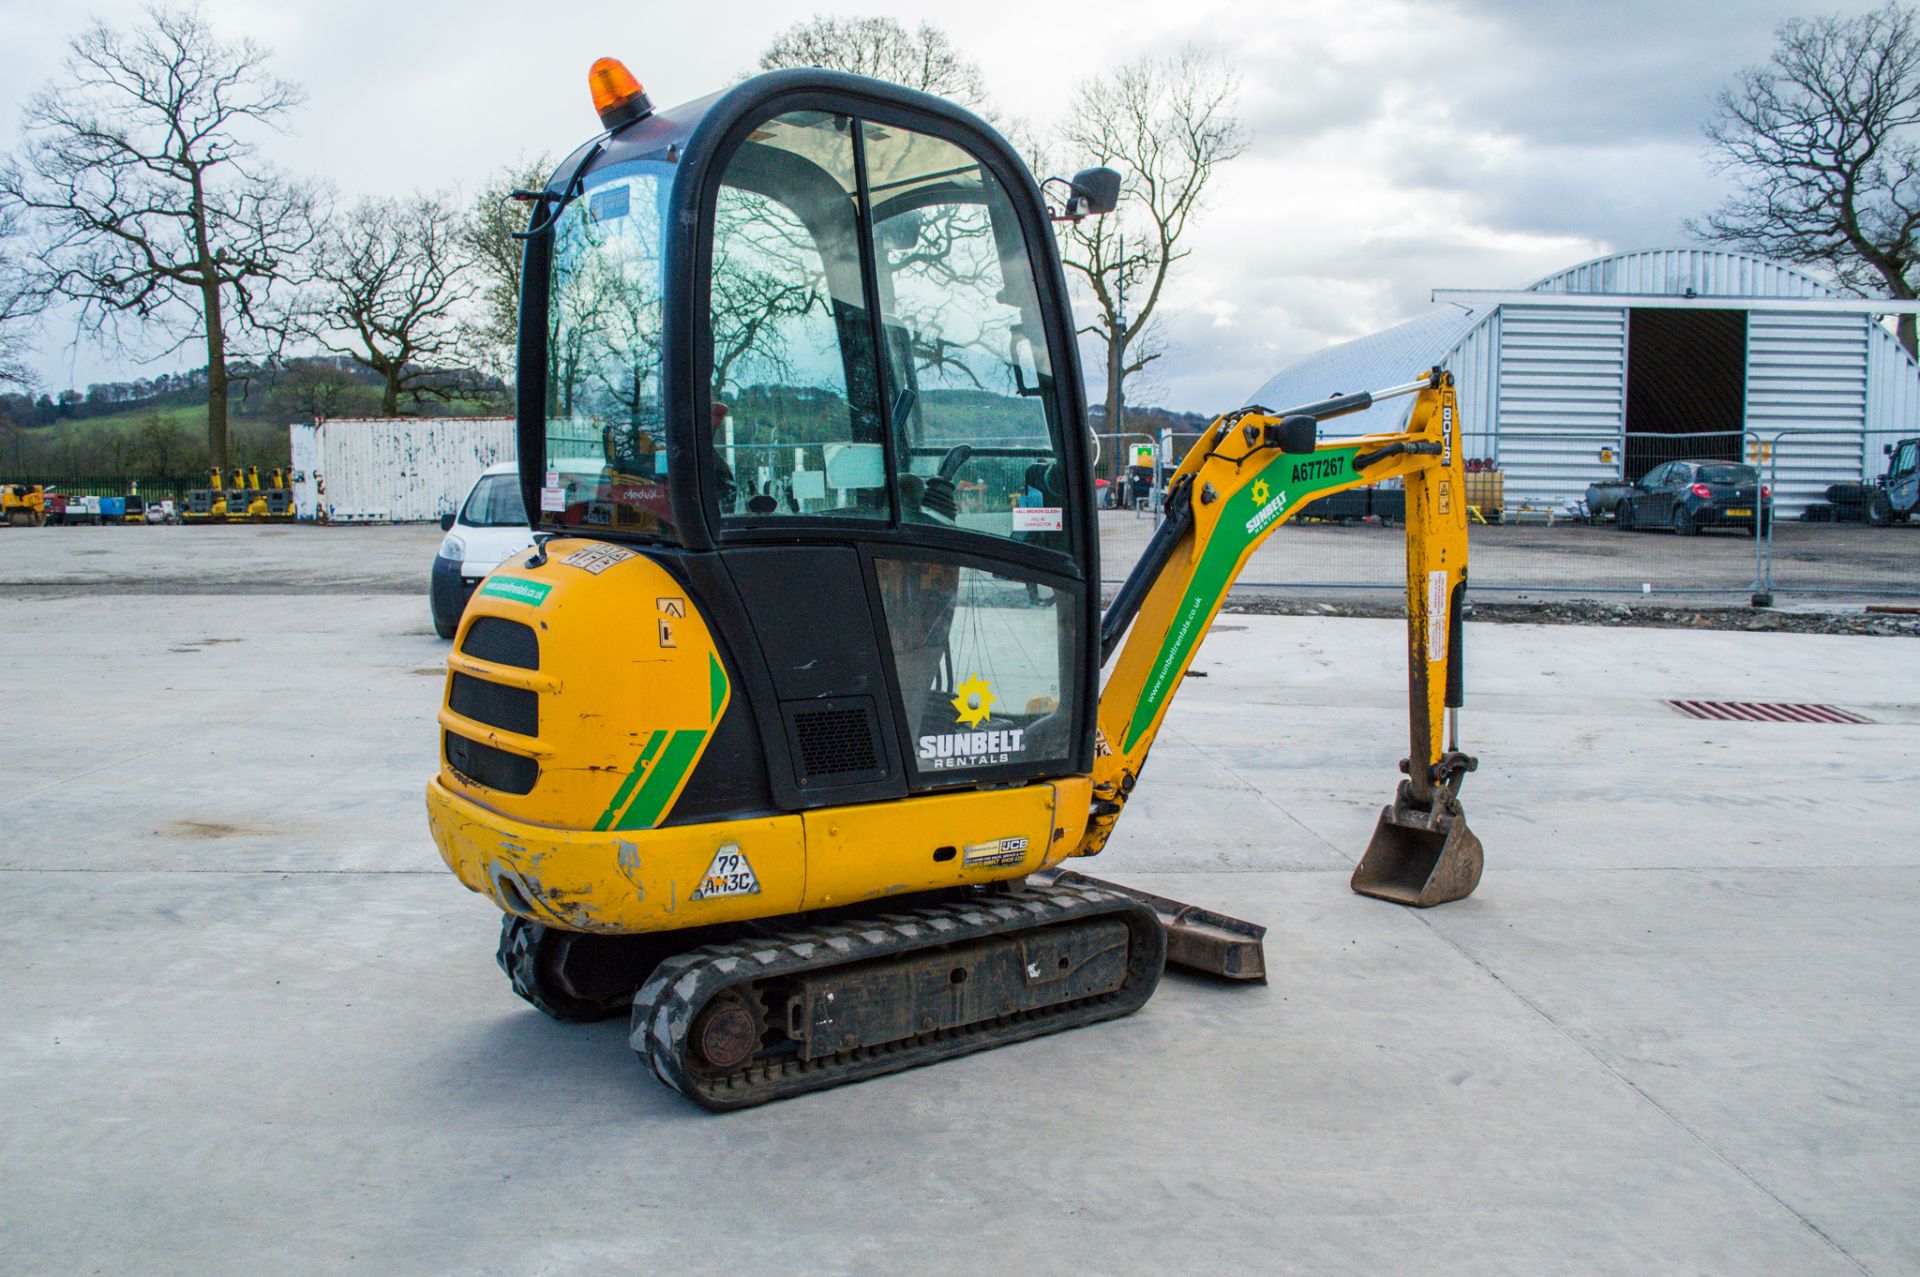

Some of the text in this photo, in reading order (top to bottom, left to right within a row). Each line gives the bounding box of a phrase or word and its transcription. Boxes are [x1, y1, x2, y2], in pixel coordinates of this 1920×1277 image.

[1291, 456, 1345, 484] A677267
[1245, 490, 1287, 534] SUNBELT
[1254, 506, 1285, 535] RENTALS
[1147, 596, 1203, 703] www.sunbeltrentals.co.uk
[919, 729, 1024, 759] SUNBELT
[934, 754, 1009, 768] RENTALS
[1002, 839, 1029, 851] JCB
[718, 855, 739, 874] 79
